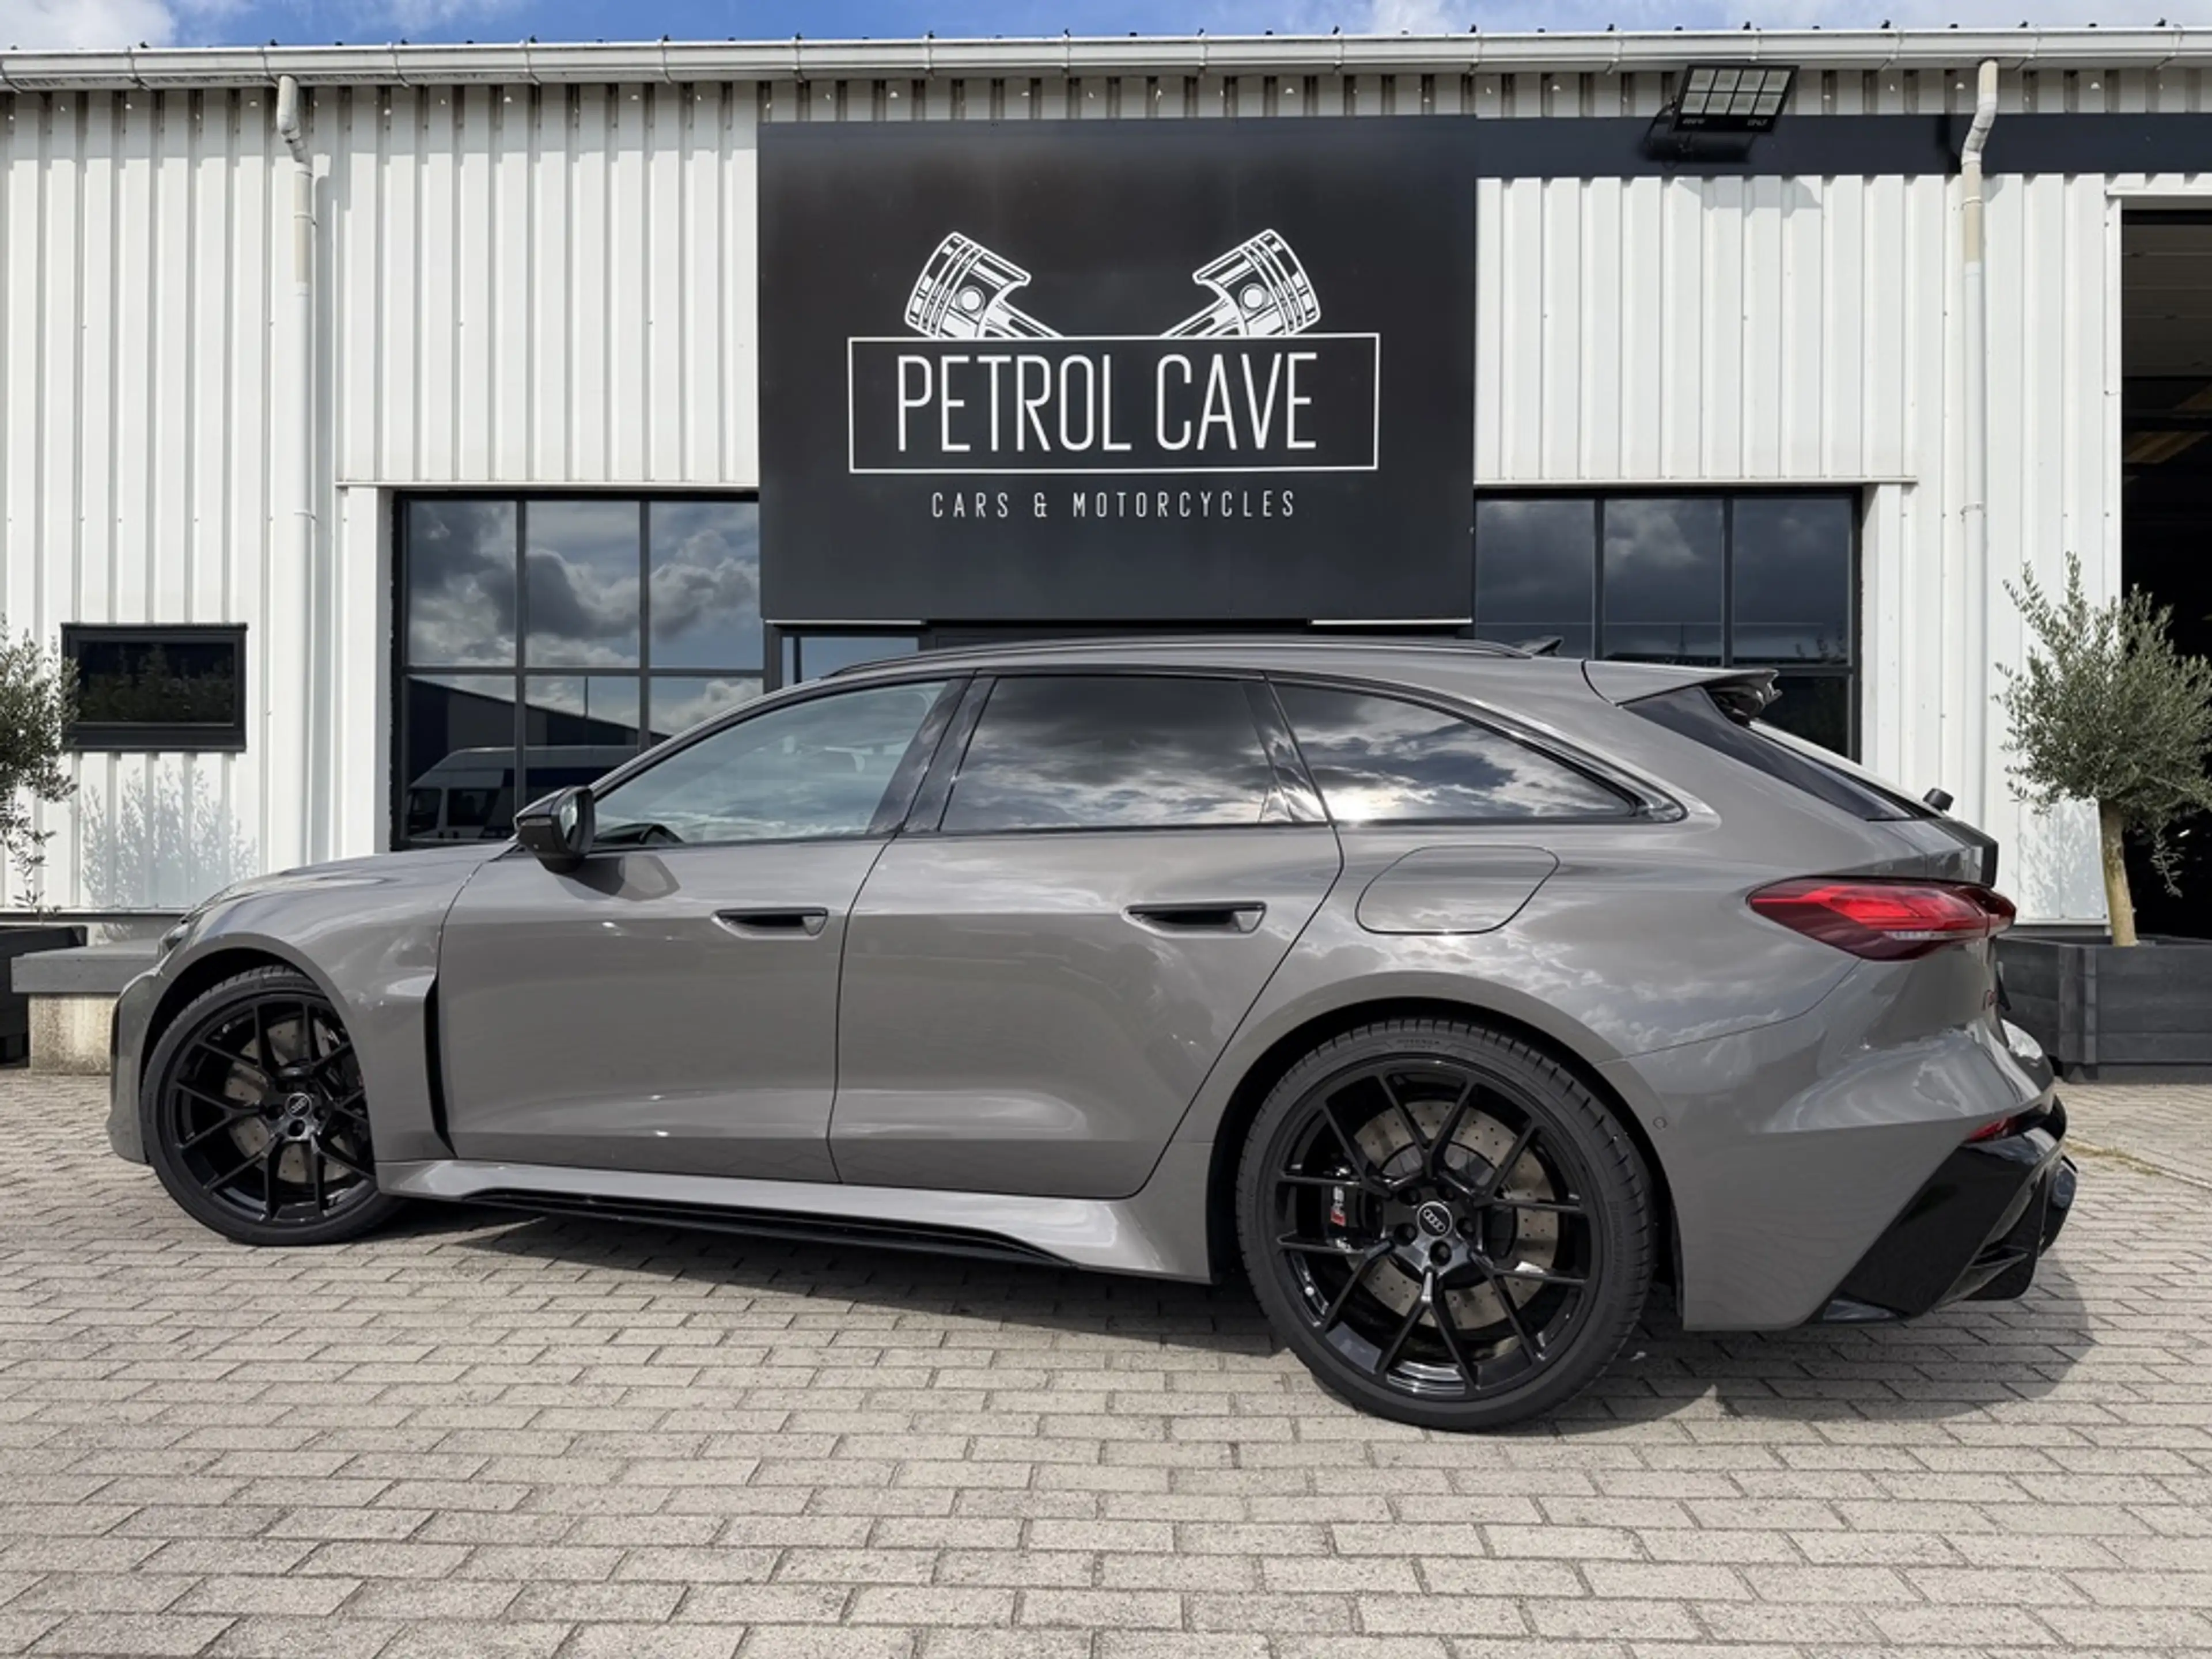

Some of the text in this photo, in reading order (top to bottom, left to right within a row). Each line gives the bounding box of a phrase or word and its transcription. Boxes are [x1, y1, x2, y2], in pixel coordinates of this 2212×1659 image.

[897, 352, 1317, 452] PETROL CAVE
[932, 490, 1294, 518] CARS & MOTORCYCLES
